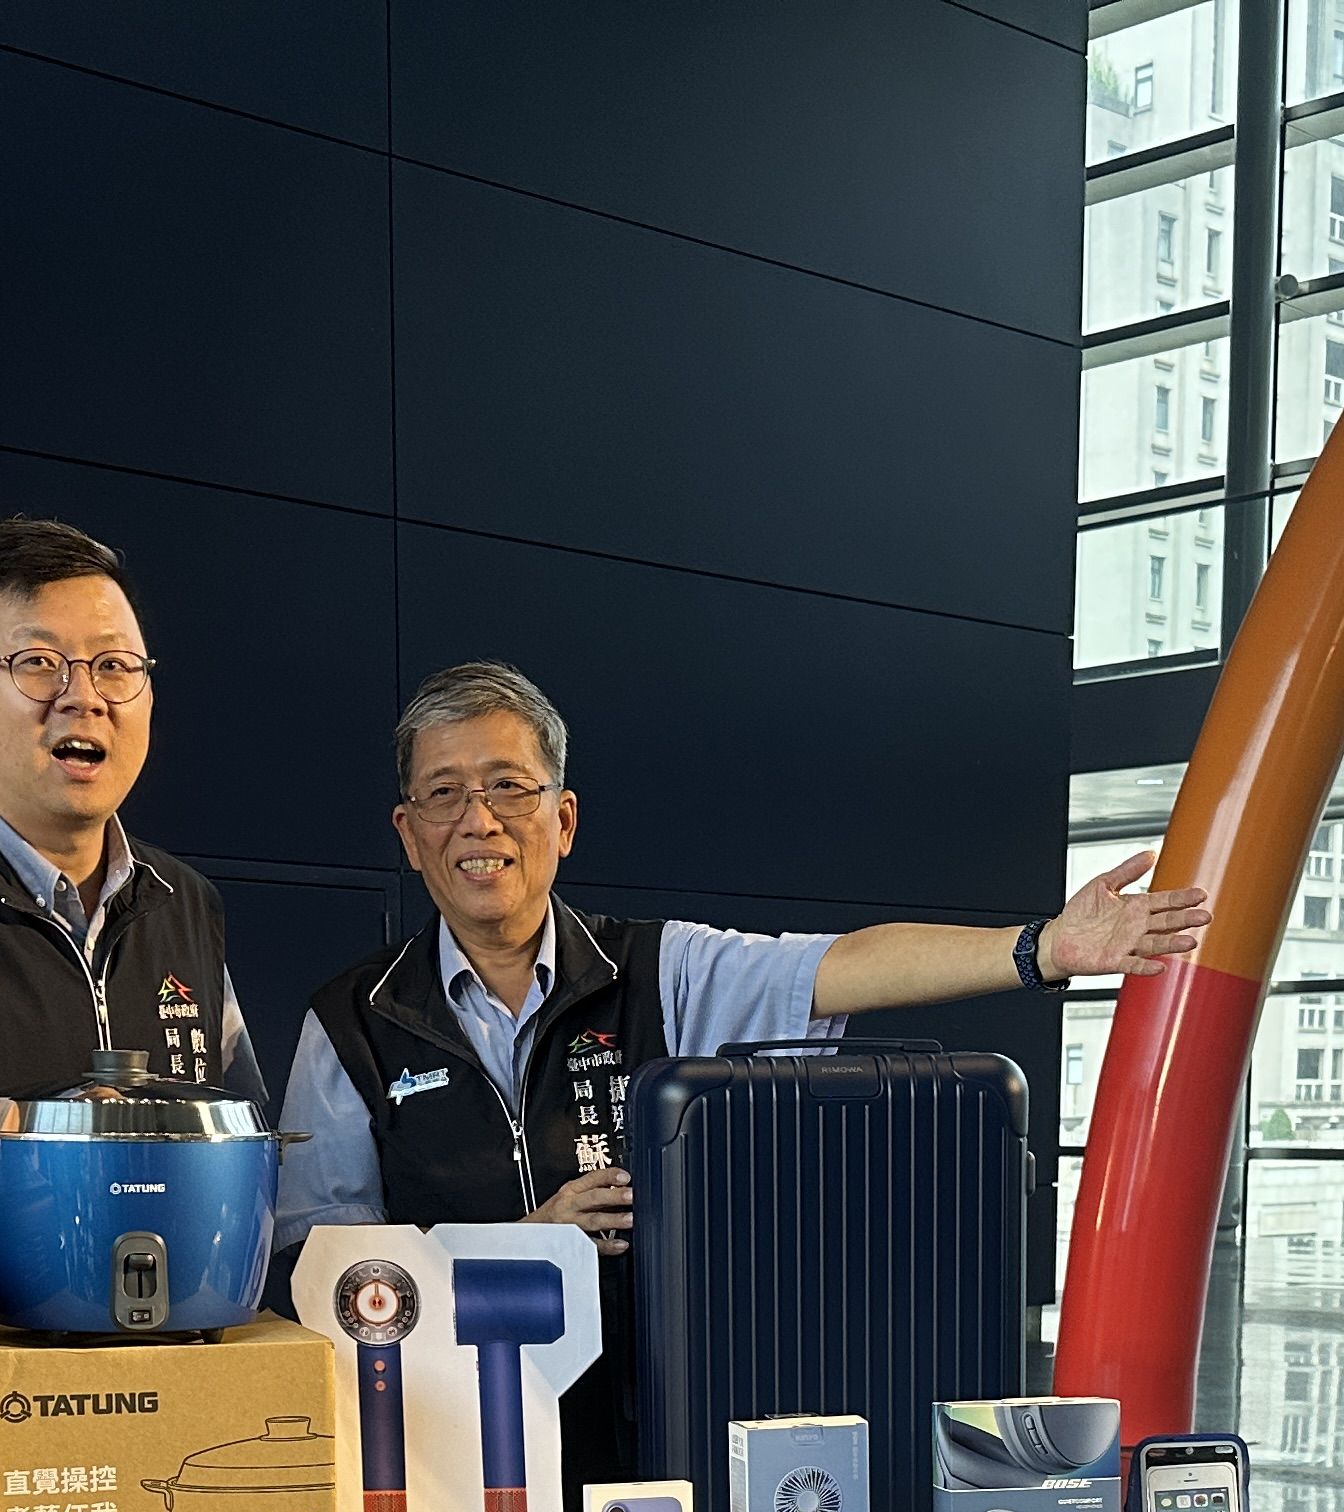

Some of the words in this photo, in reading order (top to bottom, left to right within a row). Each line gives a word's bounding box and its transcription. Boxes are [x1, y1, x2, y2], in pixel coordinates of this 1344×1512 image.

[121, 1184, 165, 1193] TATUNG
[33, 1392, 158, 1417] TATUNG
[3, 1465, 117, 1496] 直覺操控
[1042, 1479, 1092, 1489] BOSE
